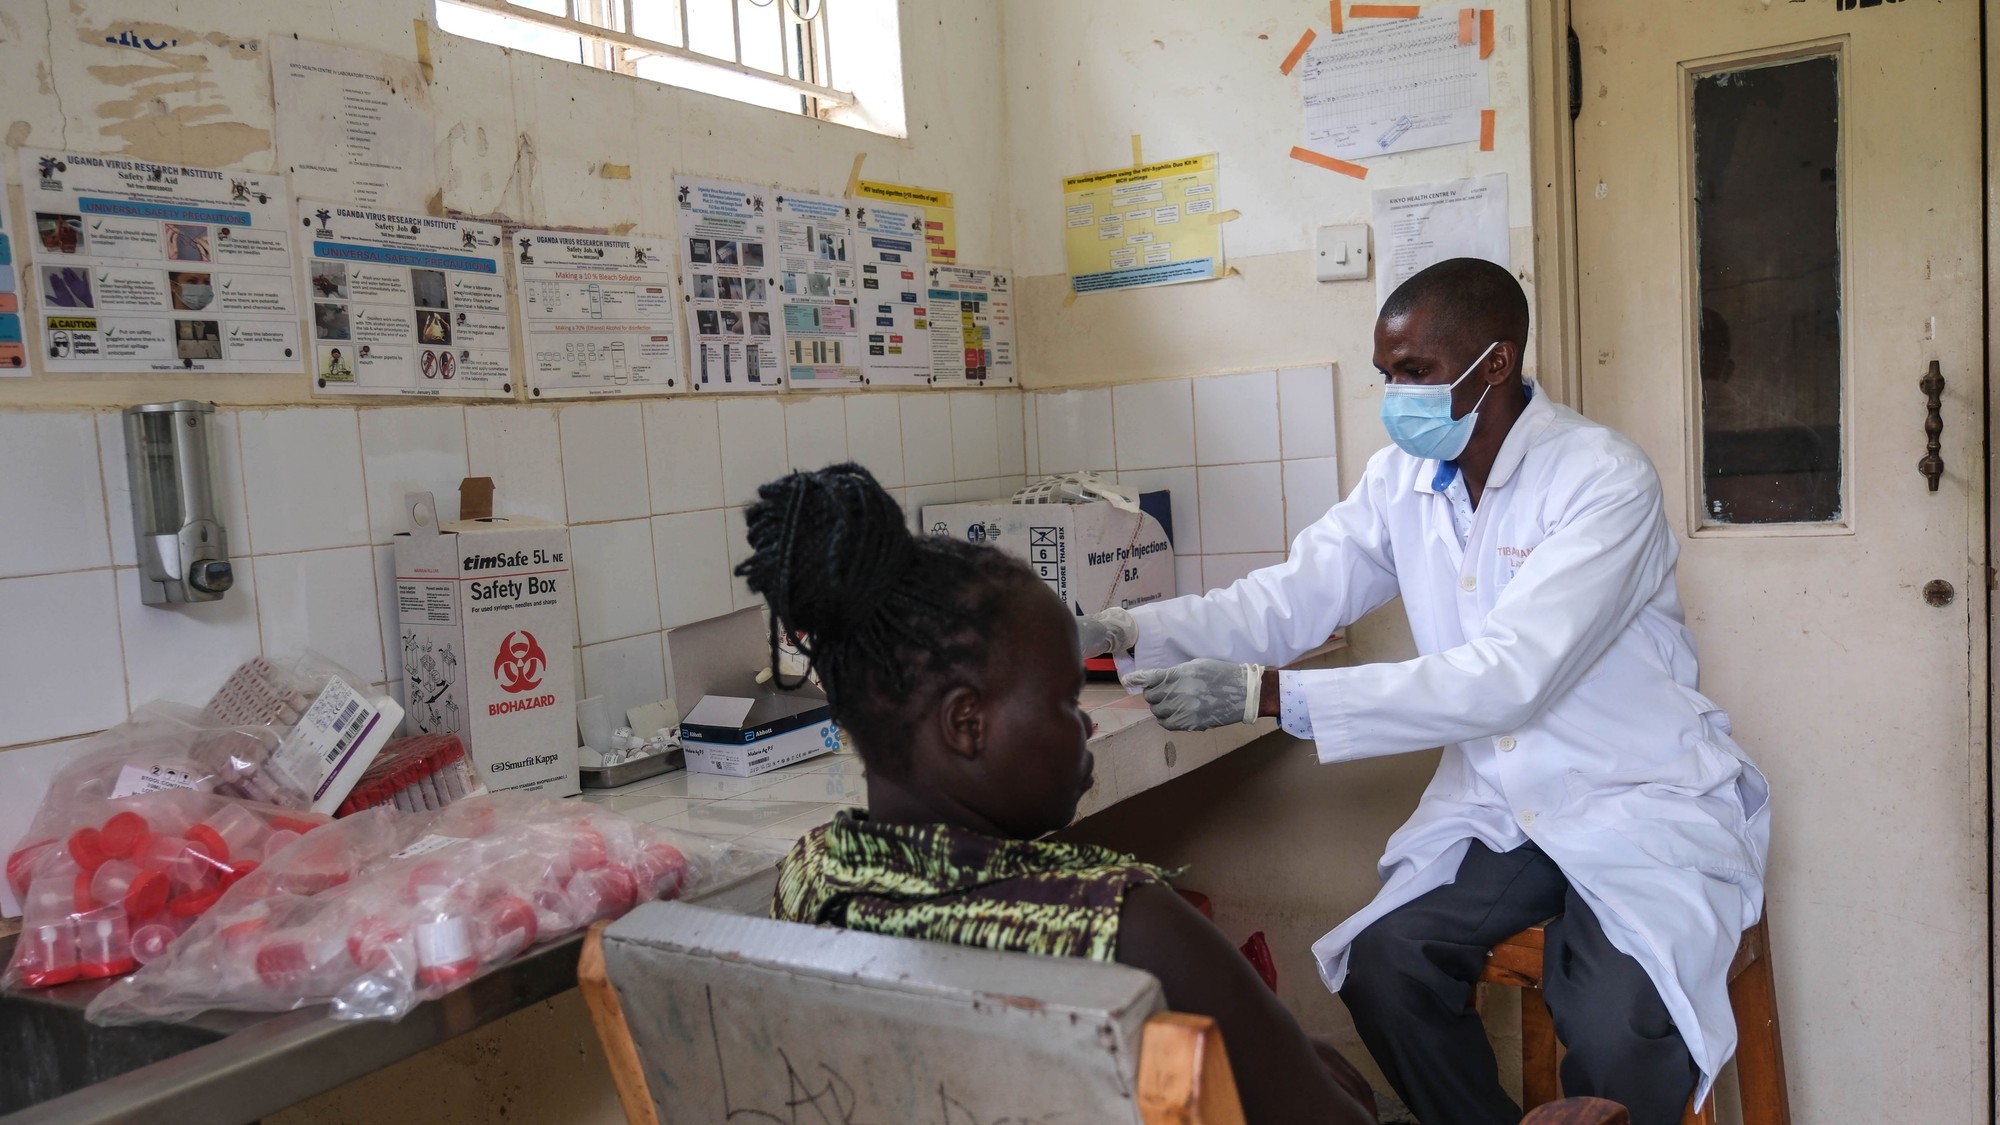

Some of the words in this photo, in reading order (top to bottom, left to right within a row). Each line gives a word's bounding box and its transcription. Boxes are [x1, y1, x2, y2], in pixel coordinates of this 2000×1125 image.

[67, 155, 104, 168] UGANDA
[106, 160, 132, 171] VIRUS
[134, 163, 178, 176] RESEARCH
[182, 168, 224, 180] INSTITUTE
[1095, 174, 1117, 182] algorithm
[1142, 164, 1172, 173] HIV-Syphilis
[1128, 174, 1148, 182] settings
[118, 172, 143, 182] Safety
[164, 176, 178, 185] Aid
[872, 188, 885, 196] testing
[1428, 192, 1450, 200] CENTRE
[87, 204, 140, 215] UNIVERSAL
[144, 208, 180, 218] SAFETY
[182, 211, 246, 224] PRECAUTIONS
[336, 208, 364, 219] UGANDA
[366, 212, 386, 222] VIRUS
[388, 215, 421, 226] RESEARCH
[424, 219, 456, 230] INSTITUTE
[374, 222, 394, 232] Safety
[396, 224, 408, 232] Job
[576, 239, 604, 247] RESEARCH
[604, 240, 630, 248] INSTITUTE
[566, 246, 582, 254] Safety
[322, 248, 381, 260] UNIVERSAL
[384, 253, 420, 264] SAFETY
[424, 258, 491, 272] PRECAUTIONS
[556, 272, 578, 280] Making
[58, 320, 97, 330] CAUTION
[73, 333, 91, 342] Safety
[74, 341, 96, 349] glasses
[1039, 532, 1046, 542] 7
[1039, 549, 1047, 560] 6
[1088, 552, 1114, 566] Water
[1116, 548, 1130, 560] For
[1132, 541, 1168, 559] Injections
[464, 550, 528, 570] timSafe
[534, 550, 550, 564] 5L
[553, 553, 564, 563] NE
[1040, 566, 1048, 577] 5
[1124, 568, 1139, 582] B.P.
[471, 579, 522, 601] Safety
[528, 576, 556, 594] Box
[488, 694, 556, 716] BIOHAZARD
[756, 728, 772, 737] Abbott
[505, 758, 534, 771] Smurfit
[535, 754, 558, 765] Kappa
[152, 767, 160, 776] 2
[142, 776, 160, 784] STOOL
